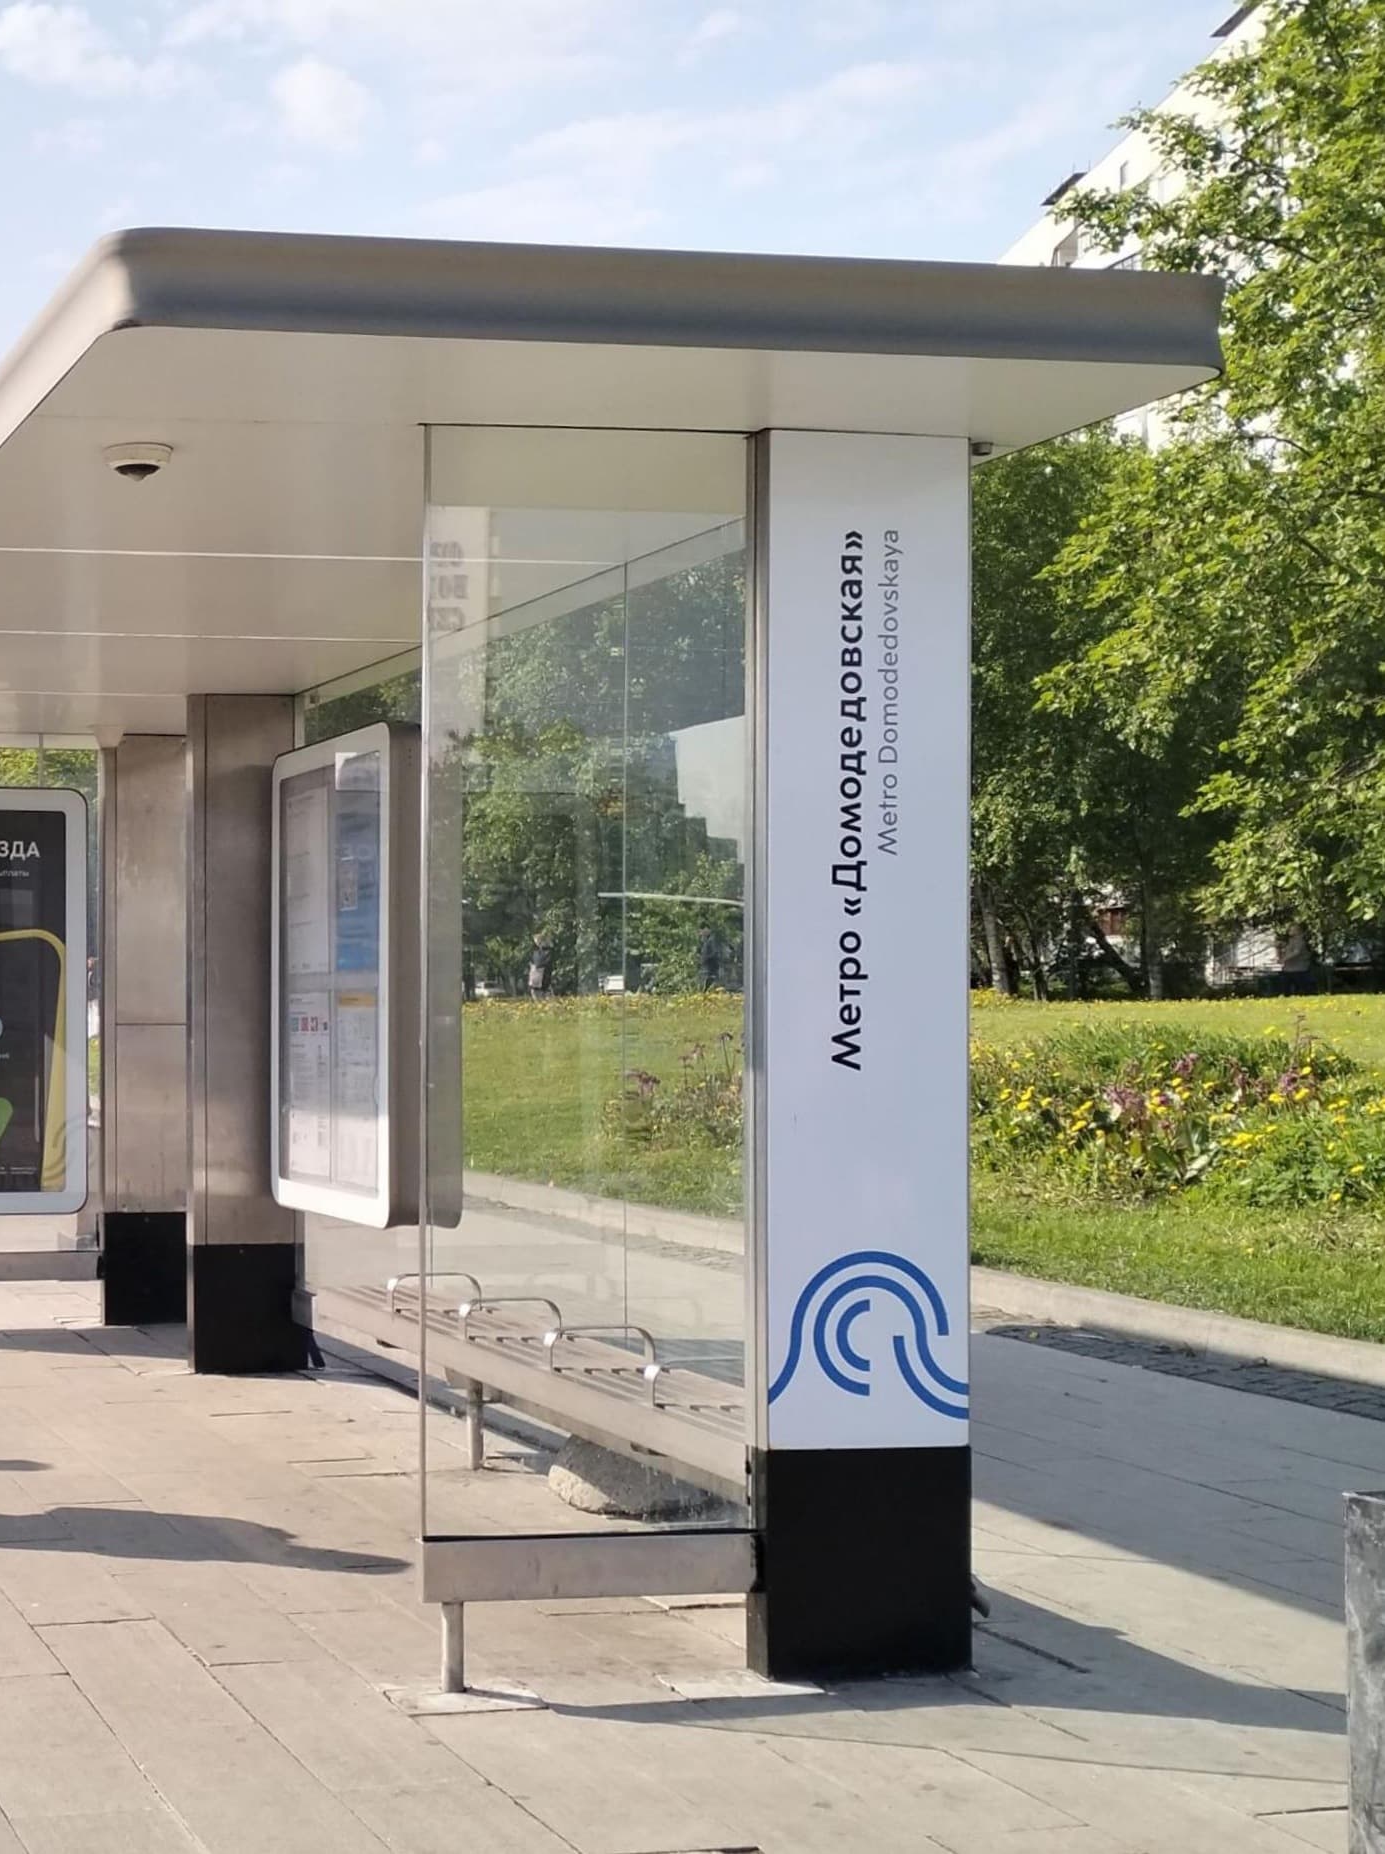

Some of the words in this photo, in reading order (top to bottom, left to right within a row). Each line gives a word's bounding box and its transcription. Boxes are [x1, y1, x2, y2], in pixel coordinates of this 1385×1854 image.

[831, 529, 867, 917] «Домодедовская»
[877, 529, 904, 763] Domodedovskaya
[877, 774, 899, 856] Metro
[831, 930, 868, 1071] Метро
